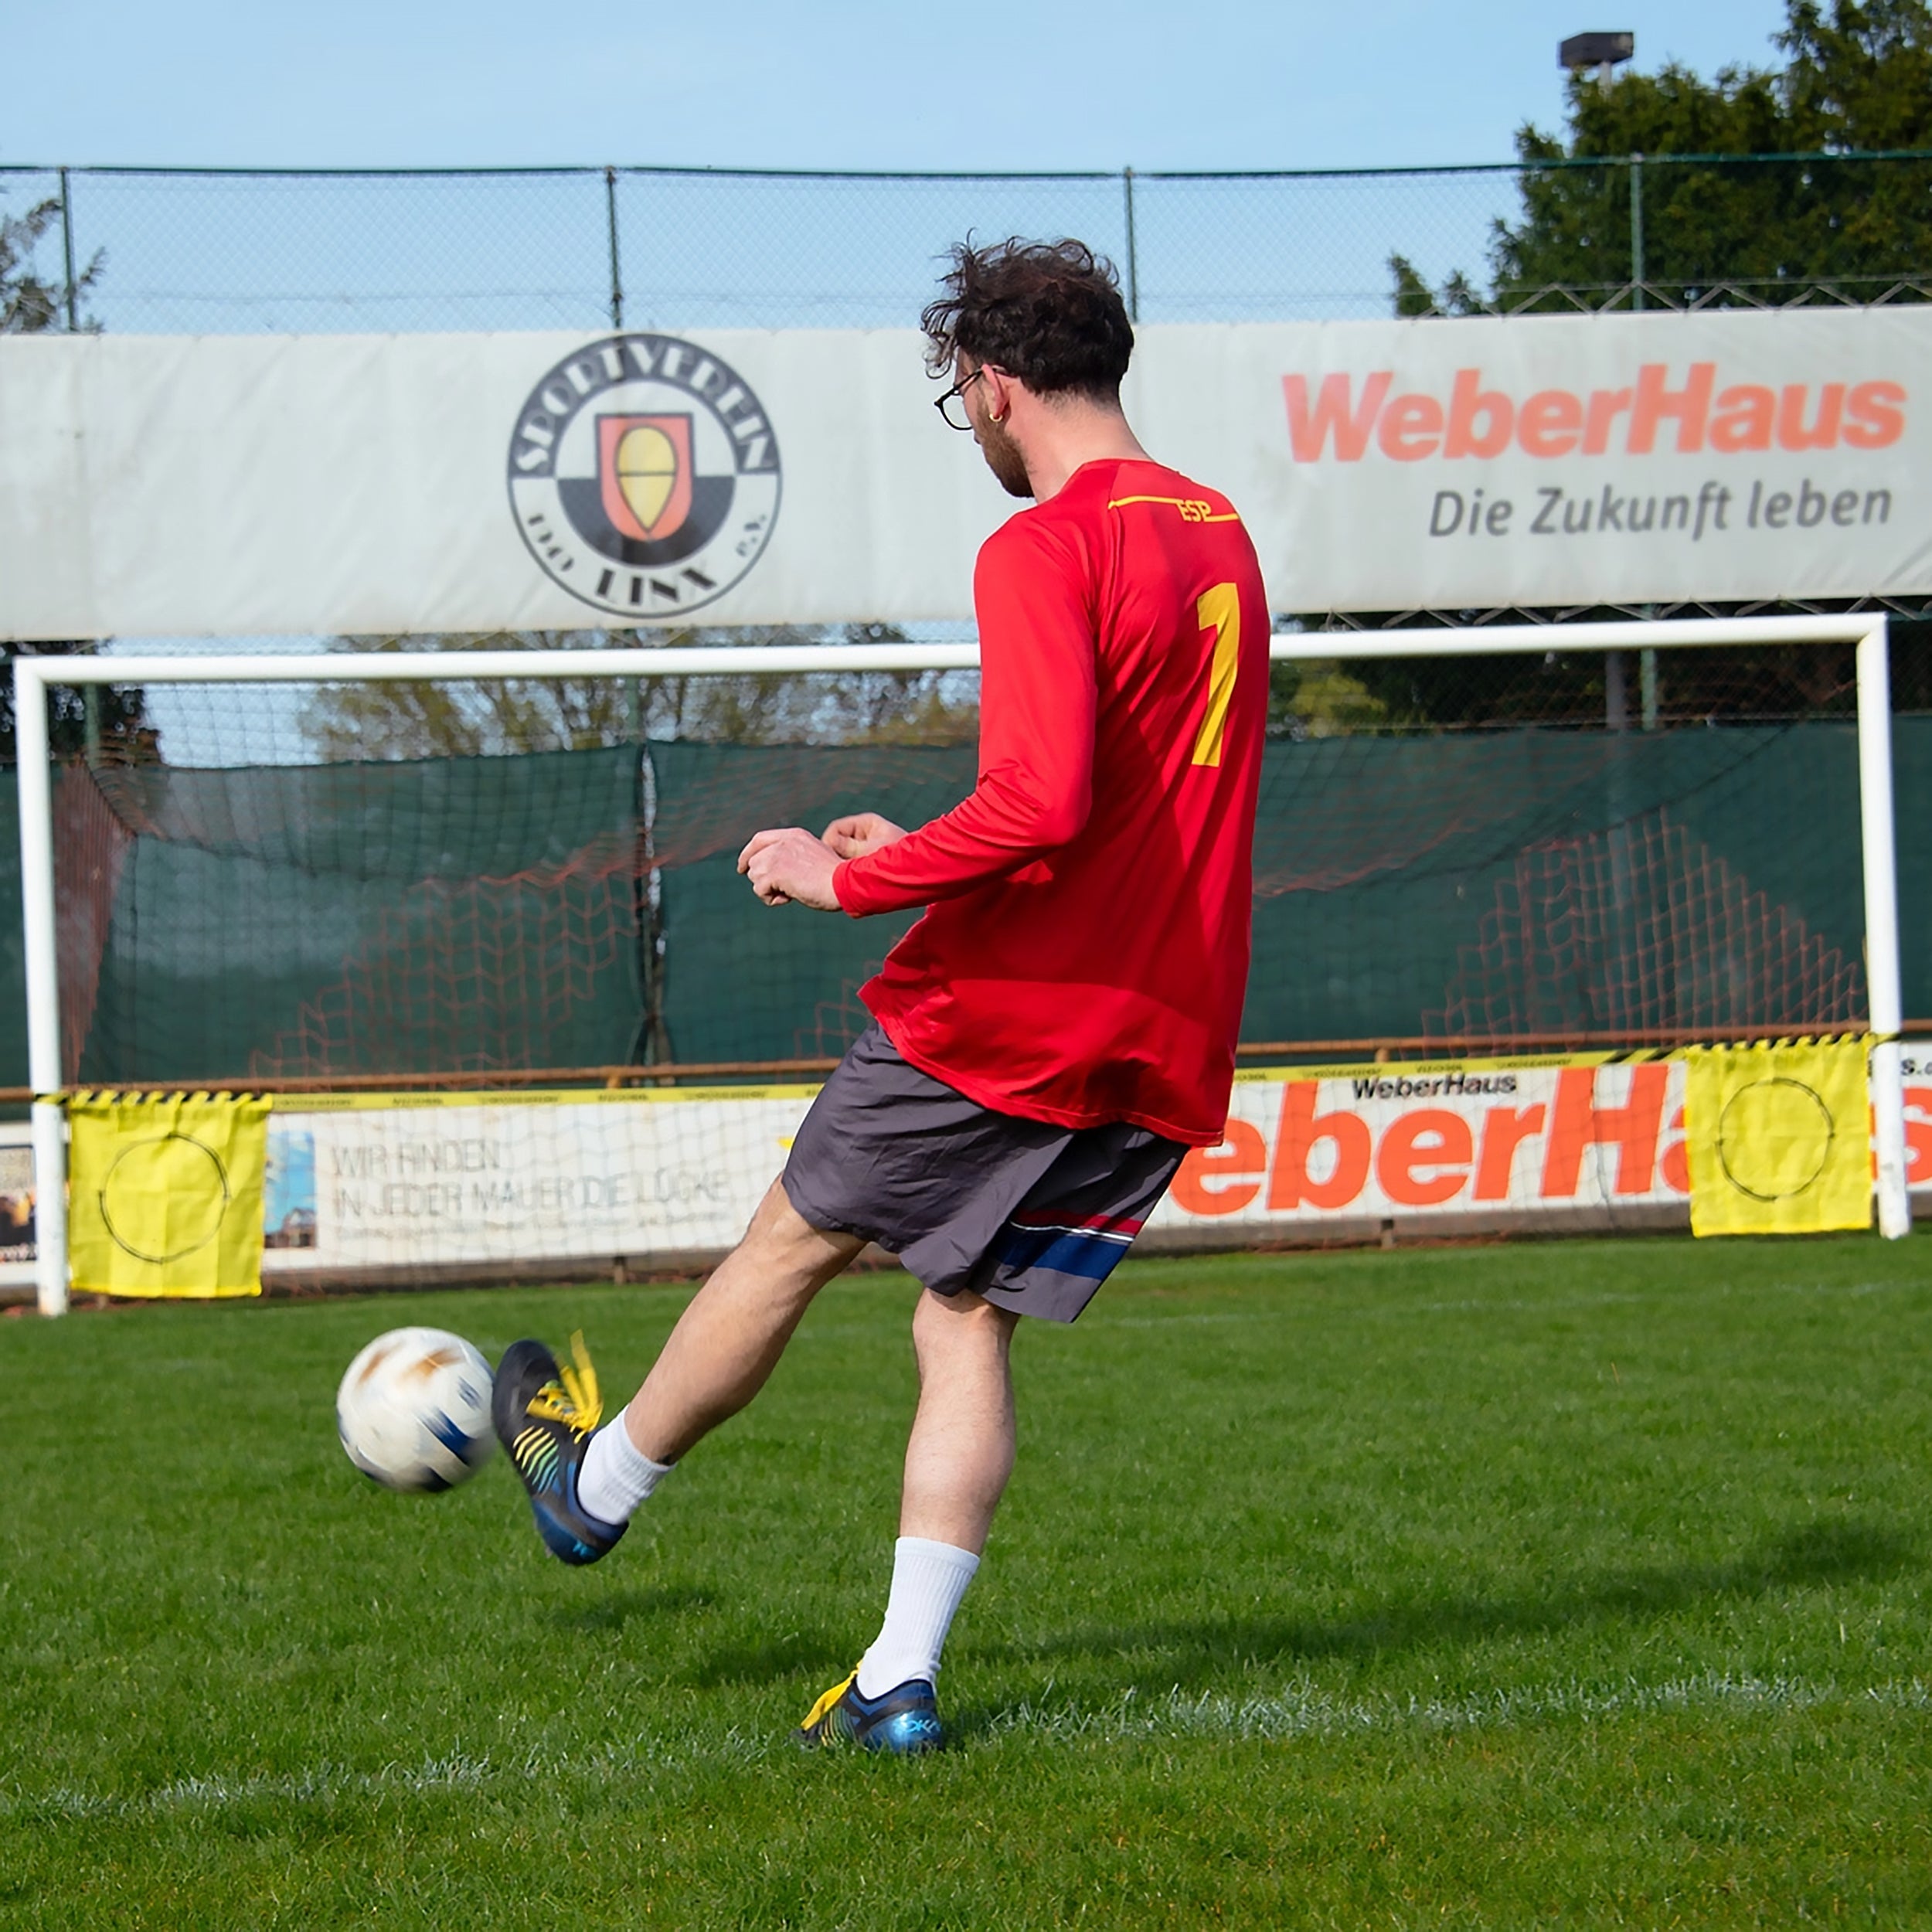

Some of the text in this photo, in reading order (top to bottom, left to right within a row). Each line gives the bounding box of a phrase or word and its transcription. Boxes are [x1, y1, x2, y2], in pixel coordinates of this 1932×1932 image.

[515, 340, 777, 473] SPORTVEREIN
[1281, 362, 1908, 464] WeberHaus
[1177, 500, 1212, 522] ESP
[1430, 479, 1893, 542] Die Zukunft leben
[595, 563, 719, 605] LINX
[1352, 1073, 1518, 1100] WeberHaus
[1170, 1062, 1932, 1216] eberH
